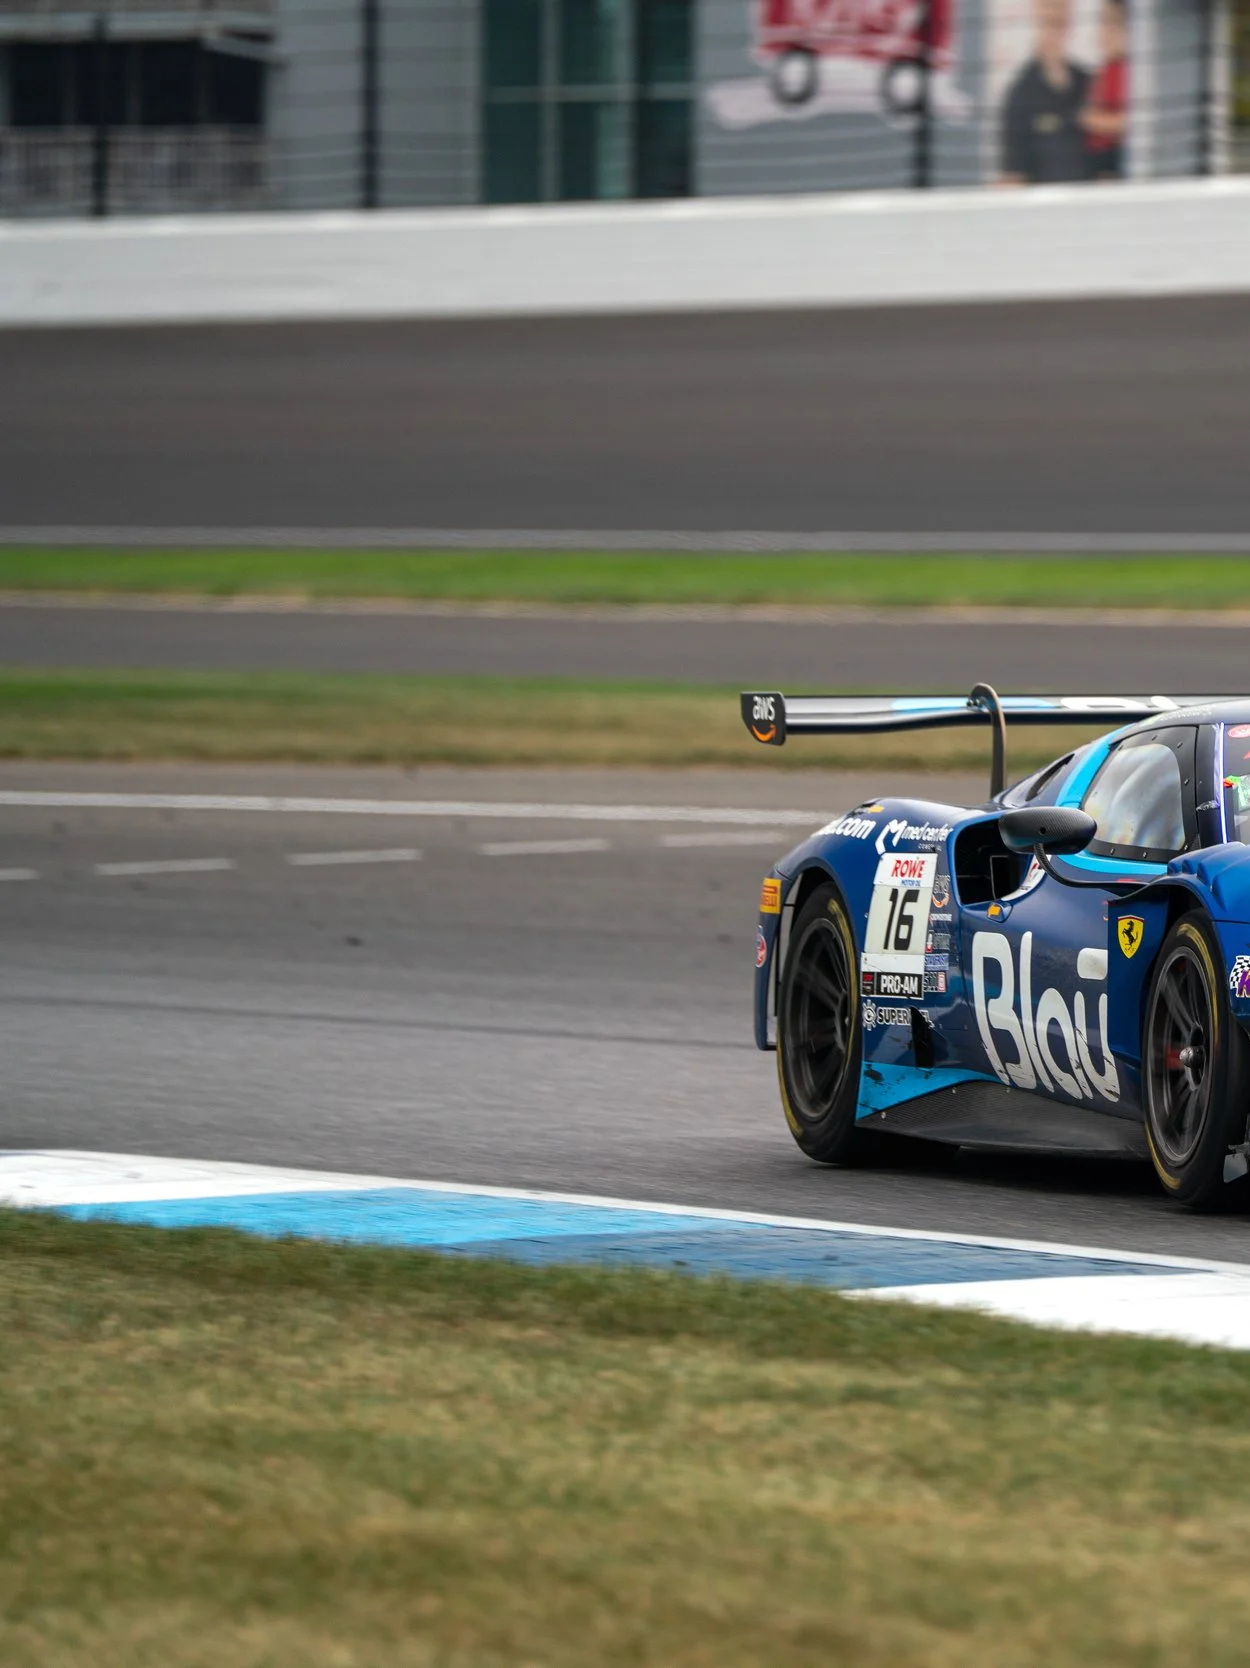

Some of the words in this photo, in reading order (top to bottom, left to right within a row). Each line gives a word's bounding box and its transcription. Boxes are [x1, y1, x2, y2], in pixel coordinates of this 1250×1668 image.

[752, 695, 776, 721] aws
[890, 859, 926, 879] ROWE
[883, 888, 920, 951] 16
[880, 974, 919, 995] PRO-AM
